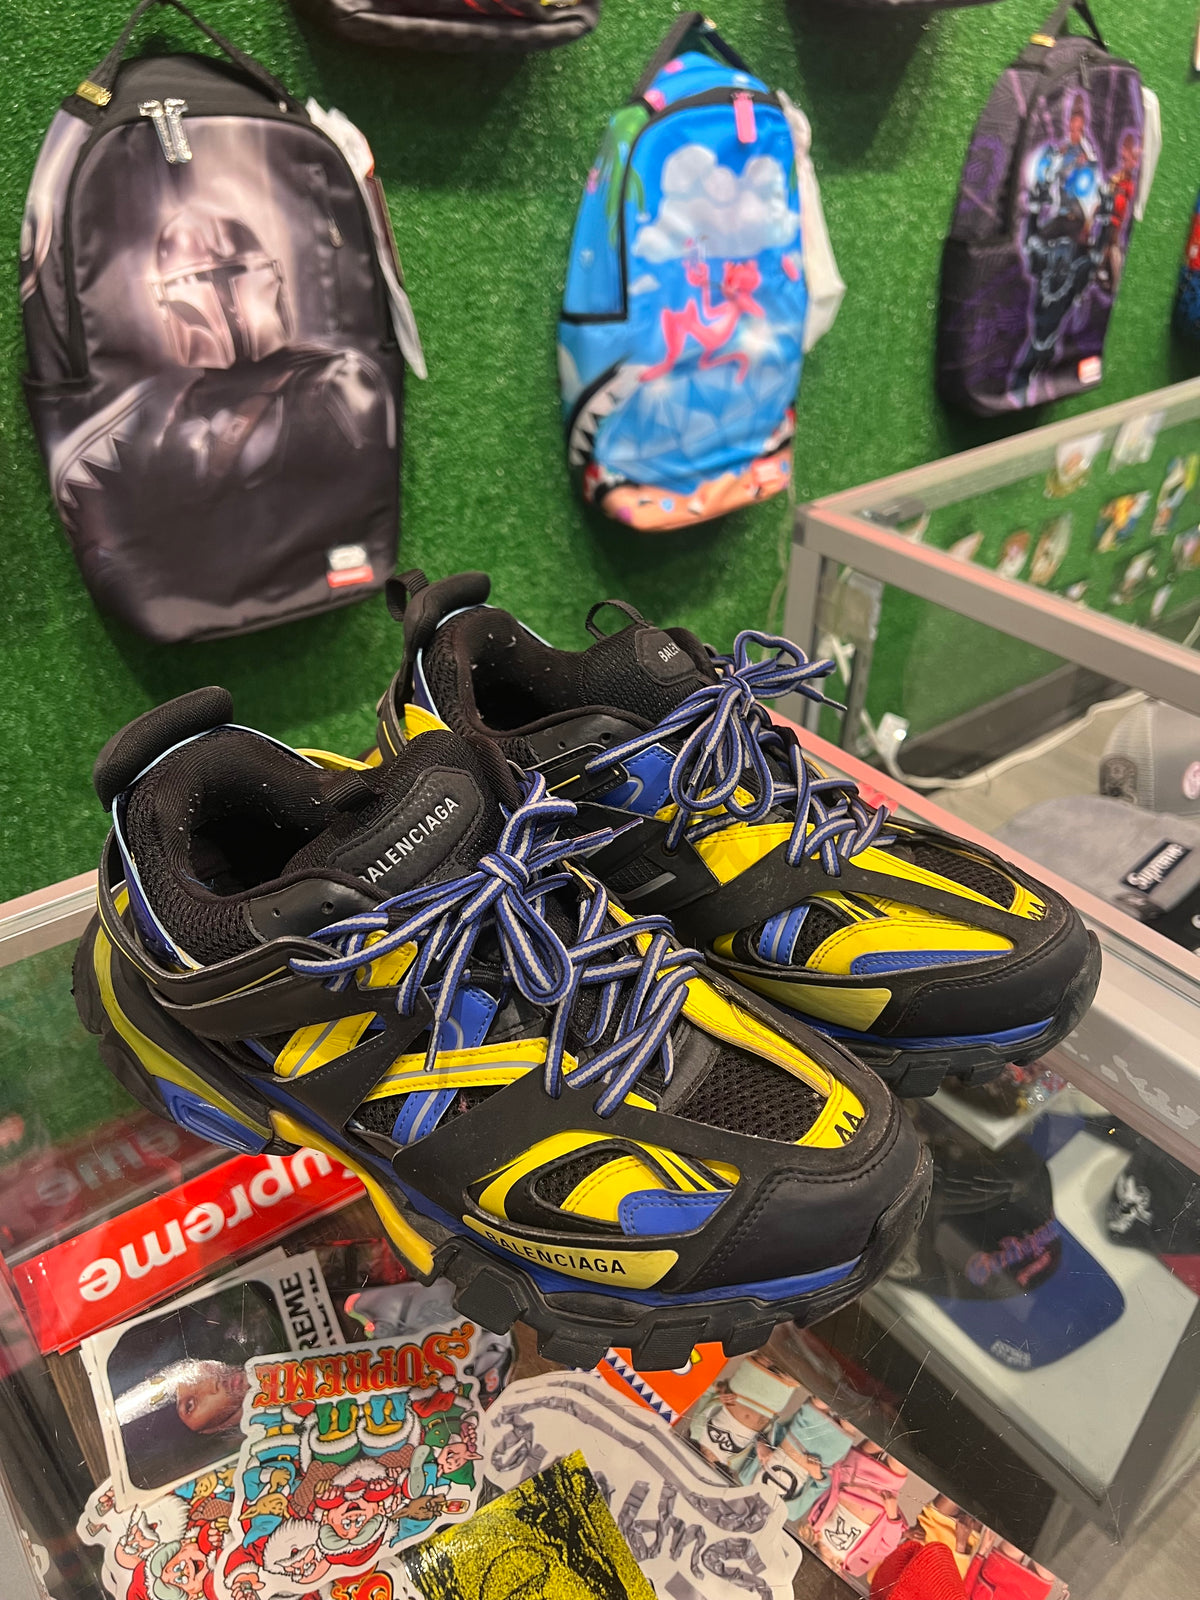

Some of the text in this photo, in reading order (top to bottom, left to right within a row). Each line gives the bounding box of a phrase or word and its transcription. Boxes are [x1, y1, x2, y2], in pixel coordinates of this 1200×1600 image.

[78, 1146, 358, 1302] upreme
[484, 1230, 627, 1276] BALENCIAGA
[280, 1271, 322, 1351] REME
[252, 1322, 476, 1409] SUPREME
